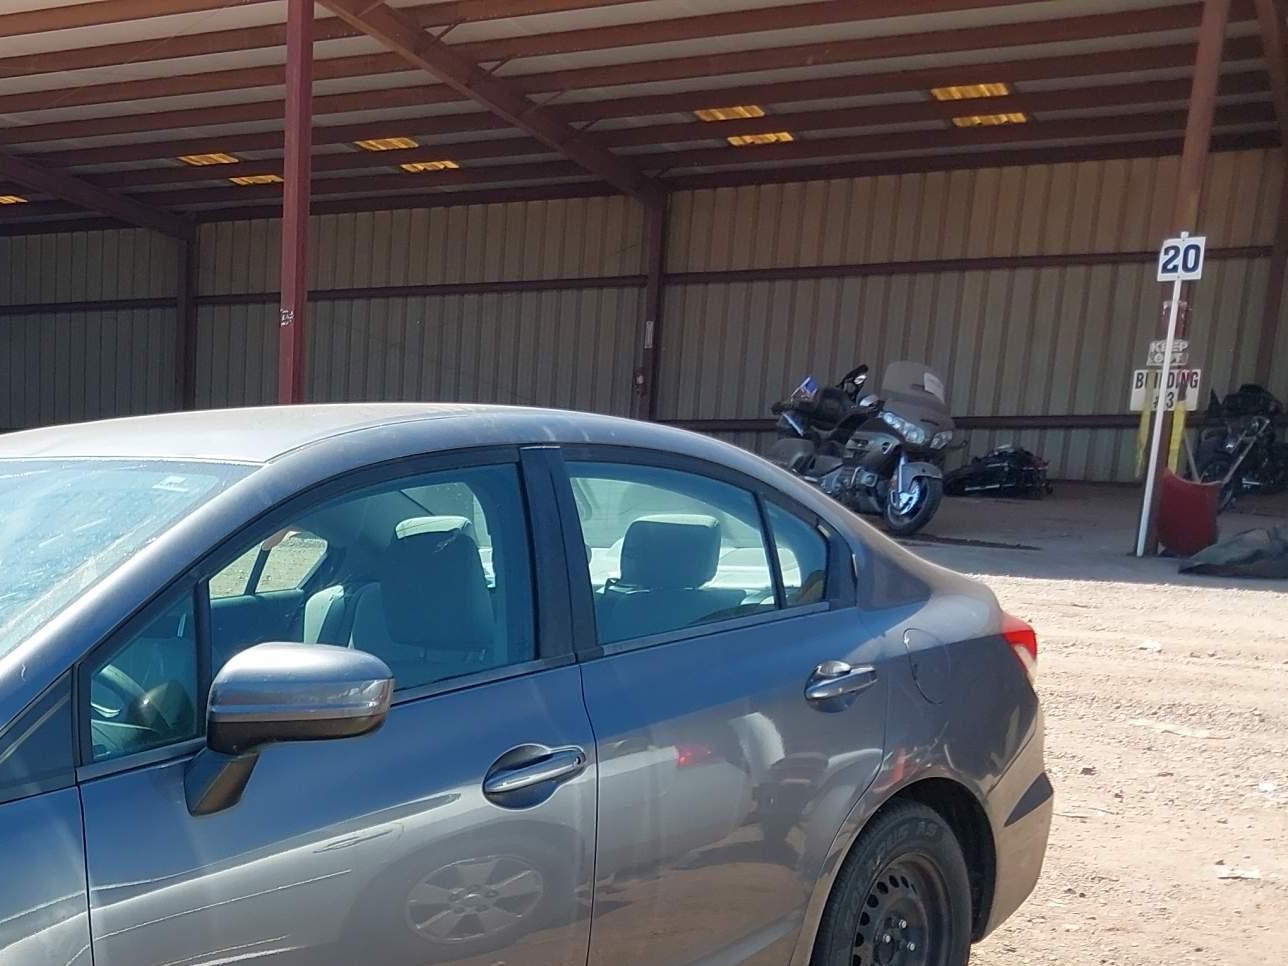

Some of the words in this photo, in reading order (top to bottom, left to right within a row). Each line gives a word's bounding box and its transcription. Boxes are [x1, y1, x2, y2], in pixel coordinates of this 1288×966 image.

[1160, 243, 1201, 274] 20
[1153, 352, 1183, 363] OT
[1135, 371, 1199, 389] BIDING
